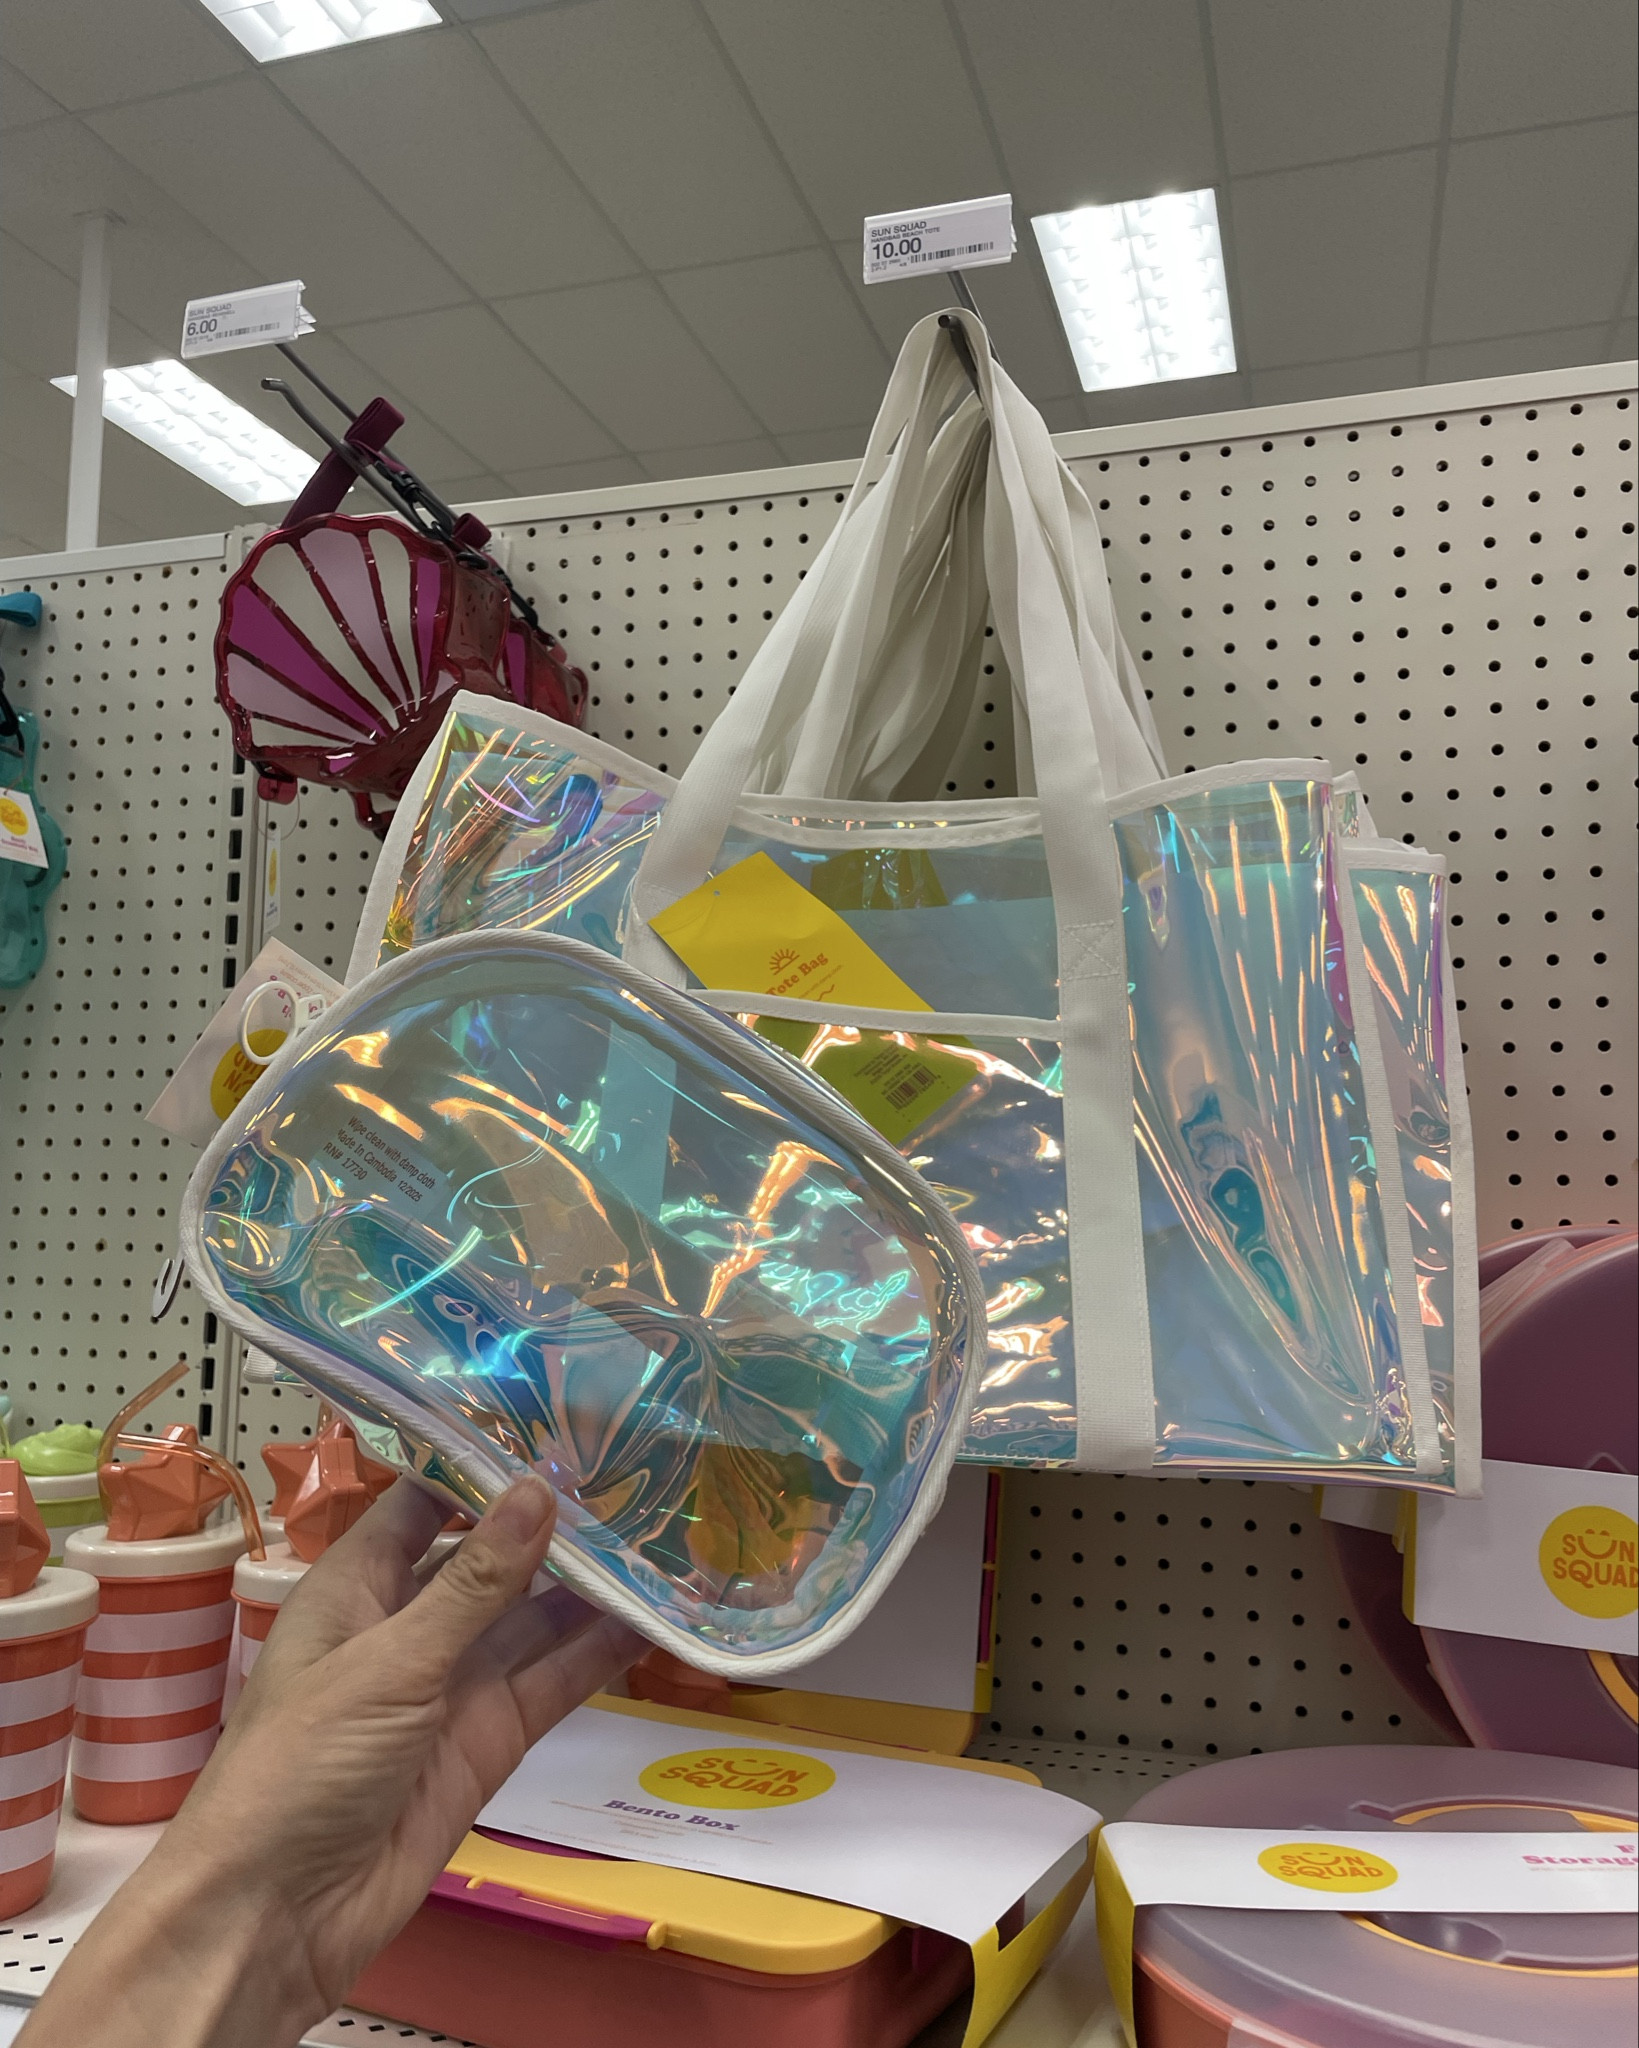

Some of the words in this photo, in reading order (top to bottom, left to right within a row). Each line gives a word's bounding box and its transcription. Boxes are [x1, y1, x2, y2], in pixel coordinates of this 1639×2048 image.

[871, 227, 892, 238] SUN
[893, 221, 927, 233] SQUAD
[902, 230, 924, 238] BEACH
[925, 227, 940, 235] TOTE
[872, 237, 922, 260] 10.00
[189, 307, 205, 317] SUN
[206, 303, 232, 314] SQUAD
[187, 319, 218, 336] 6.00
[764, 973, 799, 997] Tote
[799, 952, 829, 977] Bag
[322, 1141, 344, 1161] RN#
[341, 1157, 368, 1181] 17730
[348, 1115, 367, 1136] Wipe
[365, 1130, 386, 1151] clean
[384, 1145, 401, 1163] with
[399, 1156, 419, 1178] damp
[417, 1172, 437, 1190] cloth
[354, 1143, 364, 1156] In
[363, 1151, 398, 1183] Cambodia
[397, 1180, 423, 1202] 12/2025
[1562, 1532, 1636, 1563] SUN
[659, 1766, 799, 1798] SQUAD
[694, 1757, 810, 1784] SUN
[603, 1799, 680, 1821] Bento
[685, 1814, 741, 1831] Box
[1278, 1863, 1384, 1881] SQUAD
[1280, 1853, 1366, 1867] SUN
